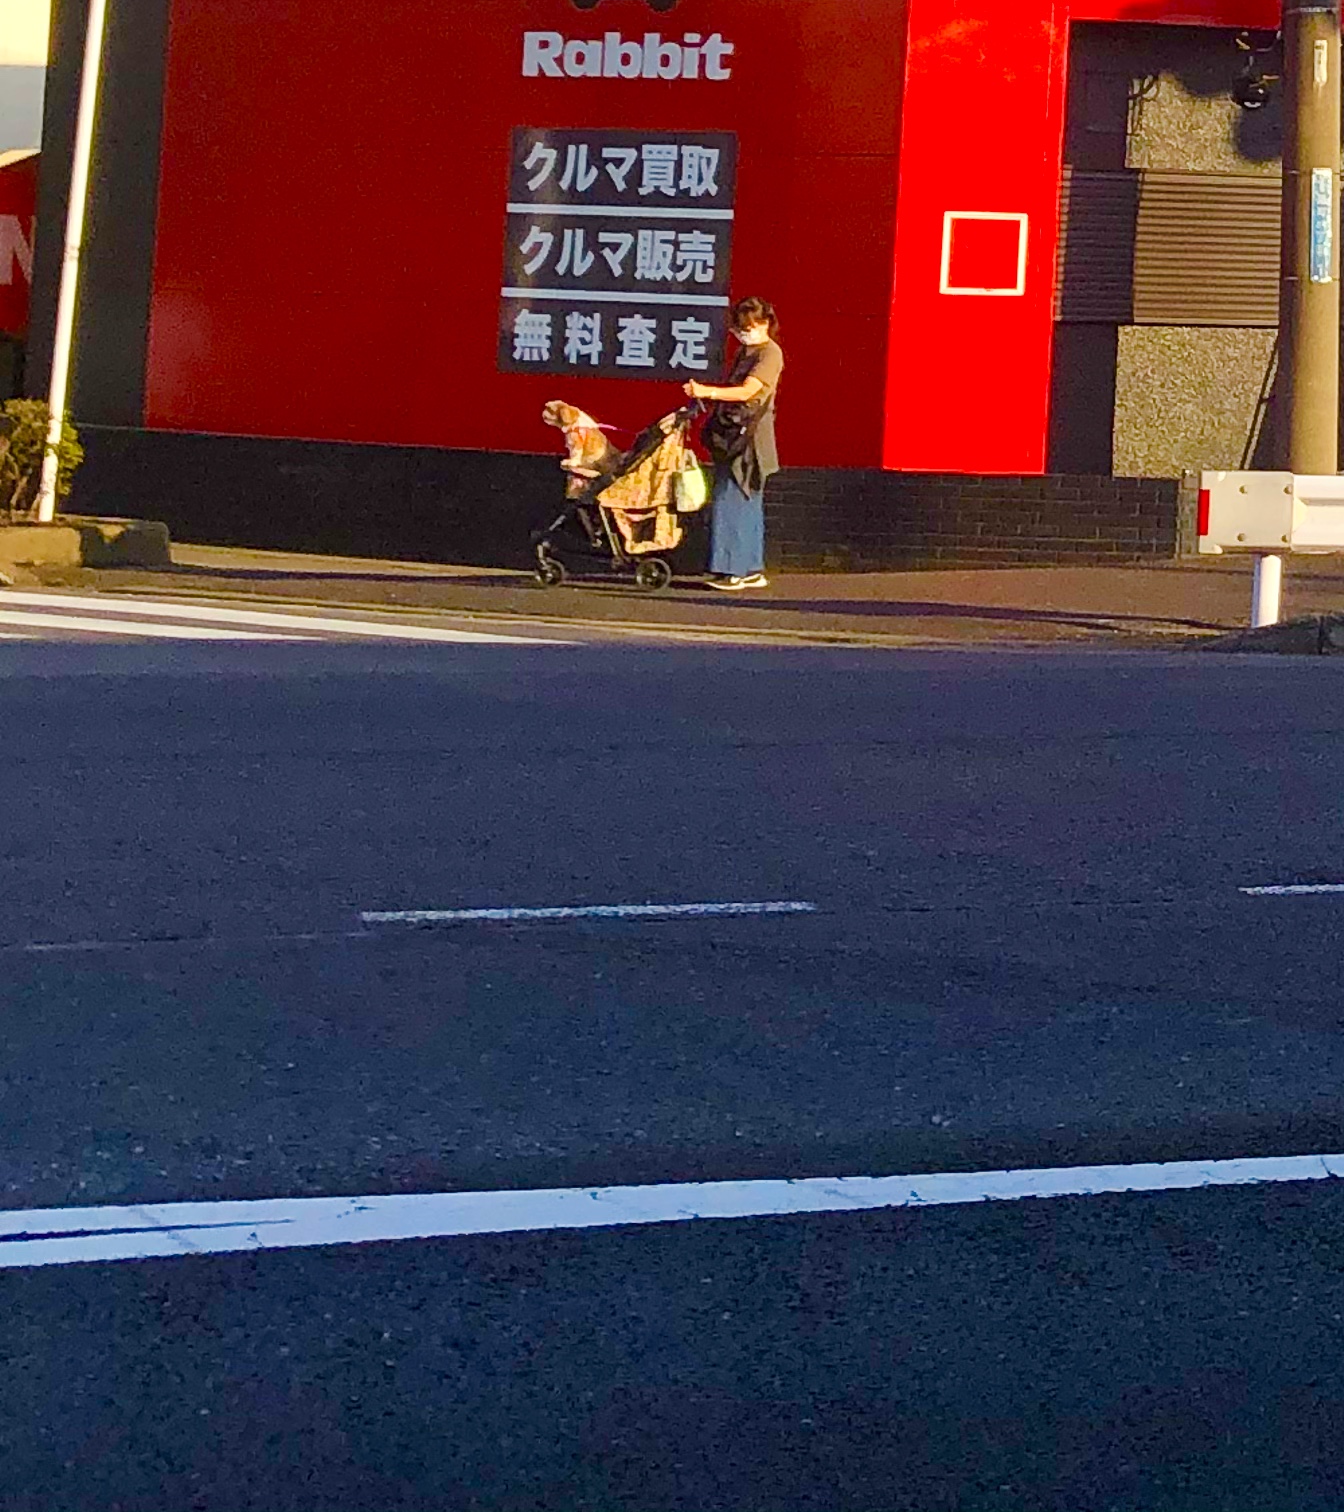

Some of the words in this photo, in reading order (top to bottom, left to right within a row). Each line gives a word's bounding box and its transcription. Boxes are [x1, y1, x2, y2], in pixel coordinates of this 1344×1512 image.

[522, 31, 735, 81] Rabbit
[523, 142, 721, 197] クルマ買取
[519, 225, 716, 283] クルマ販売
[511, 308, 711, 371] 無料査定
